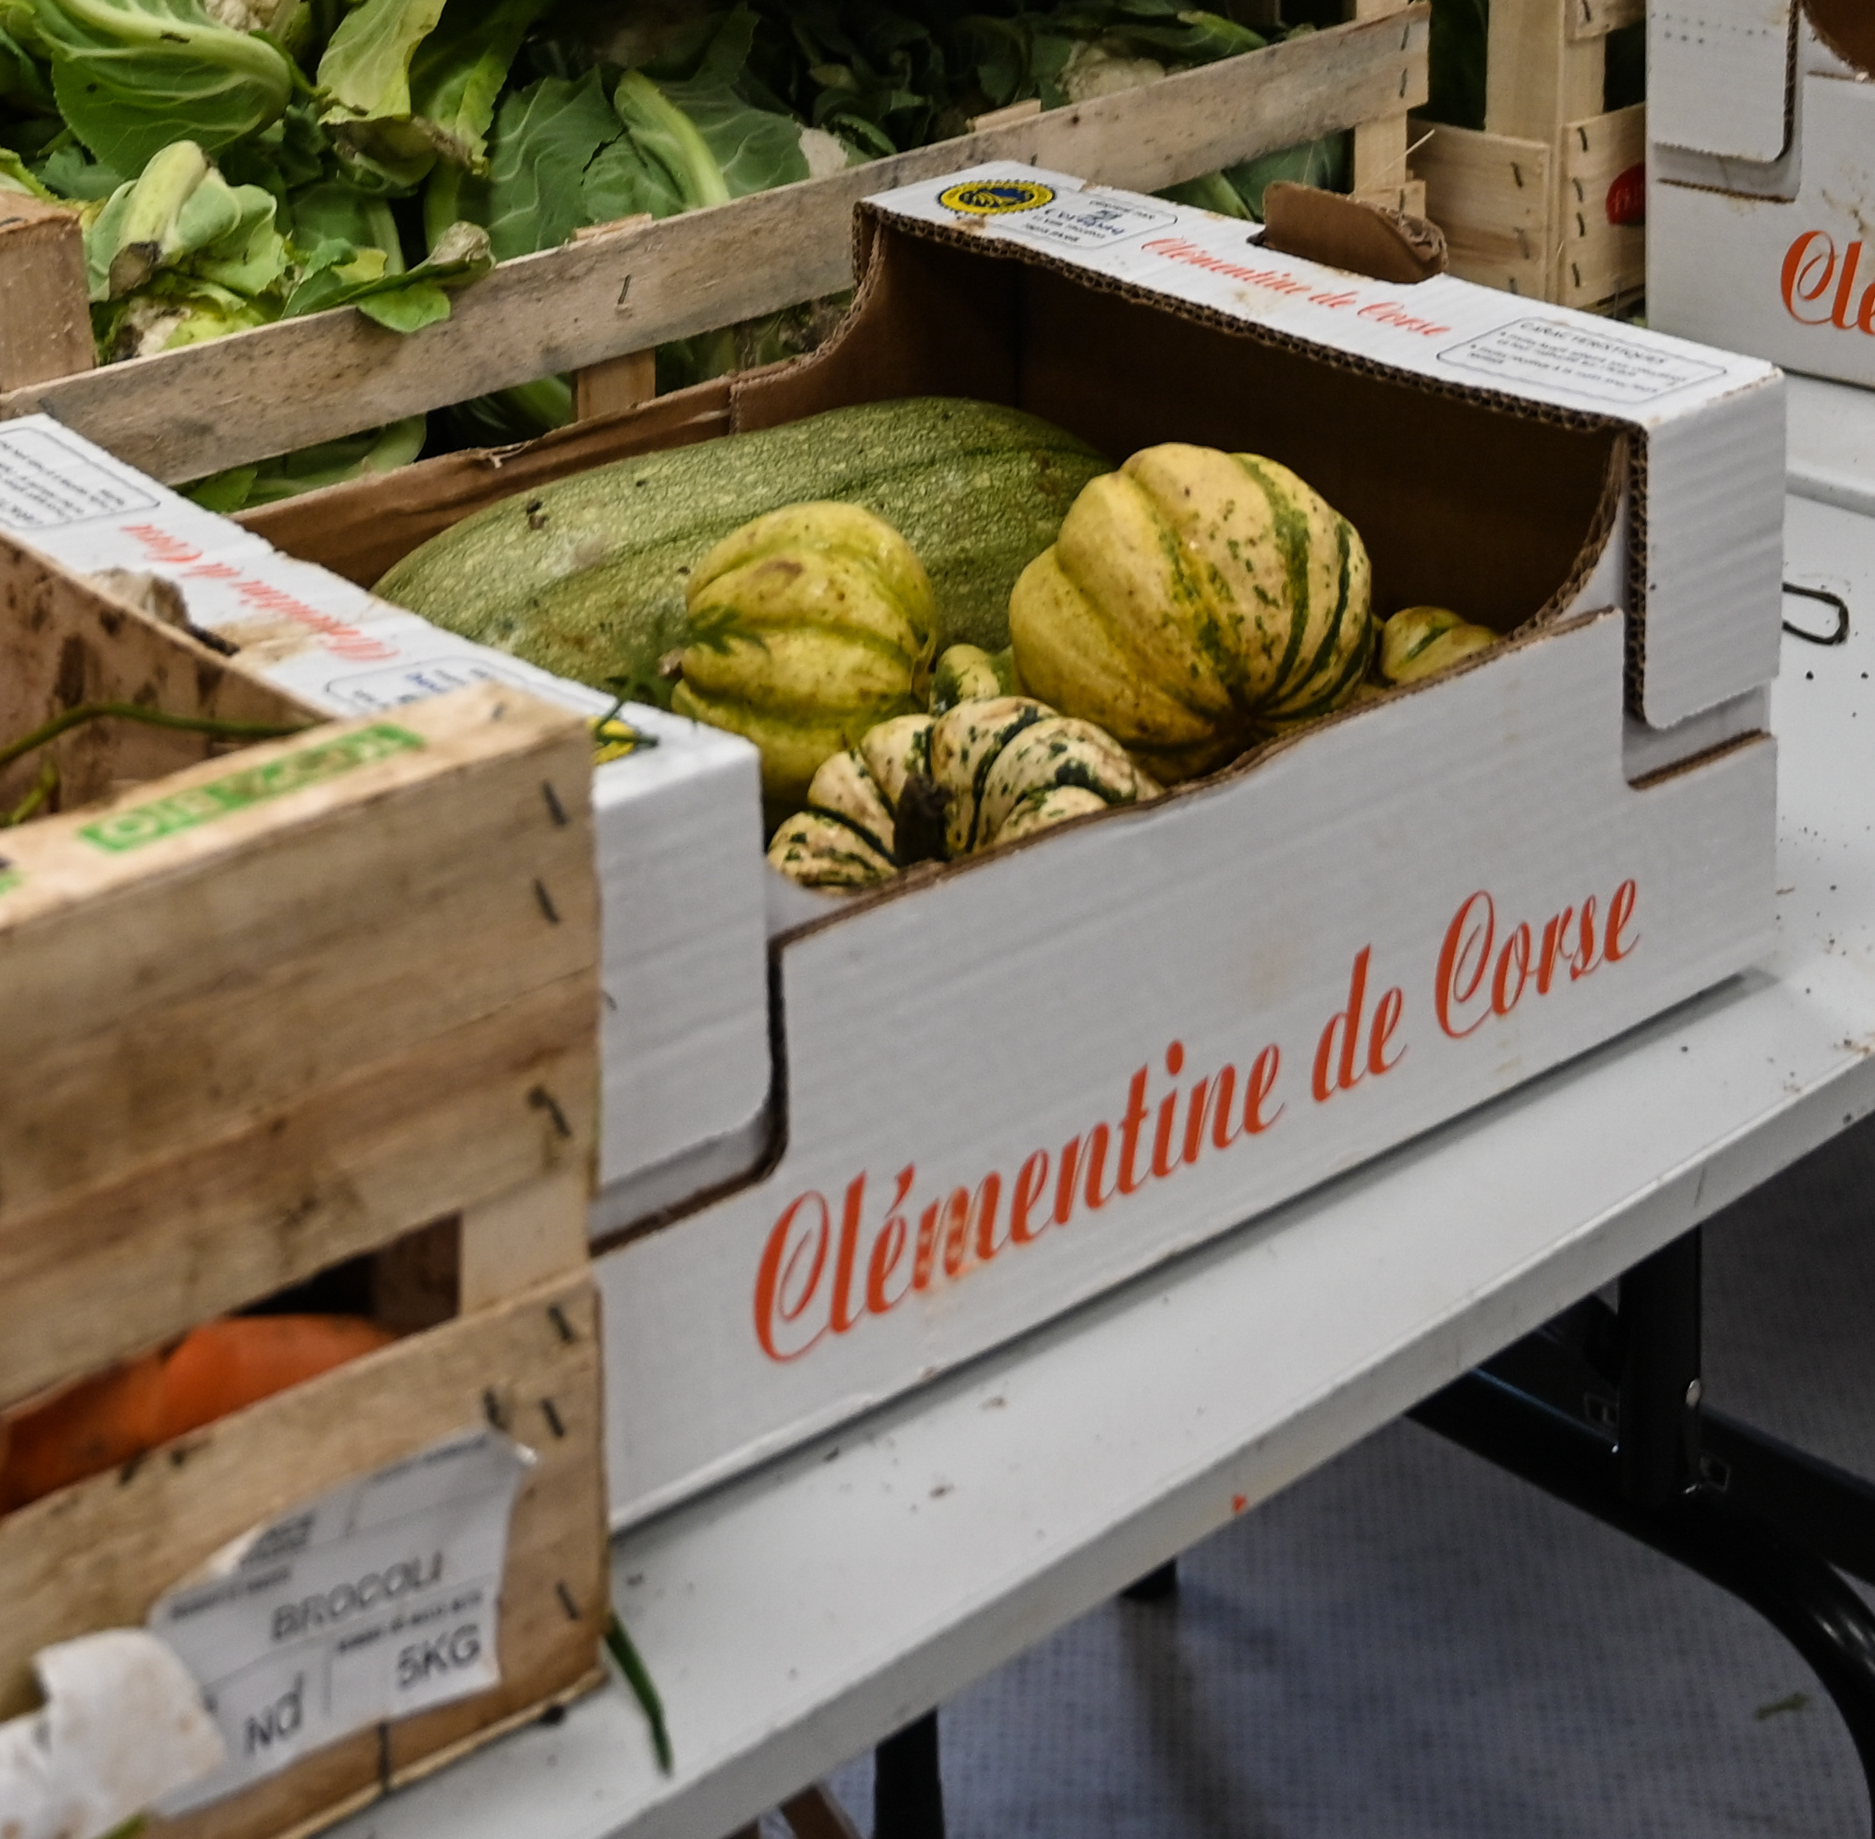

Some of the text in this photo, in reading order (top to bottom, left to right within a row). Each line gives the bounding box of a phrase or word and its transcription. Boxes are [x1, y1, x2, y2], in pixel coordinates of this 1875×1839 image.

[1141, 235, 1451, 336] Clémentine de Corse
[753, 877, 1639, 1362] Clémentine de Corse
[271, 1550, 443, 1641] BROCOLI
[398, 1623, 482, 1691] 5KG
